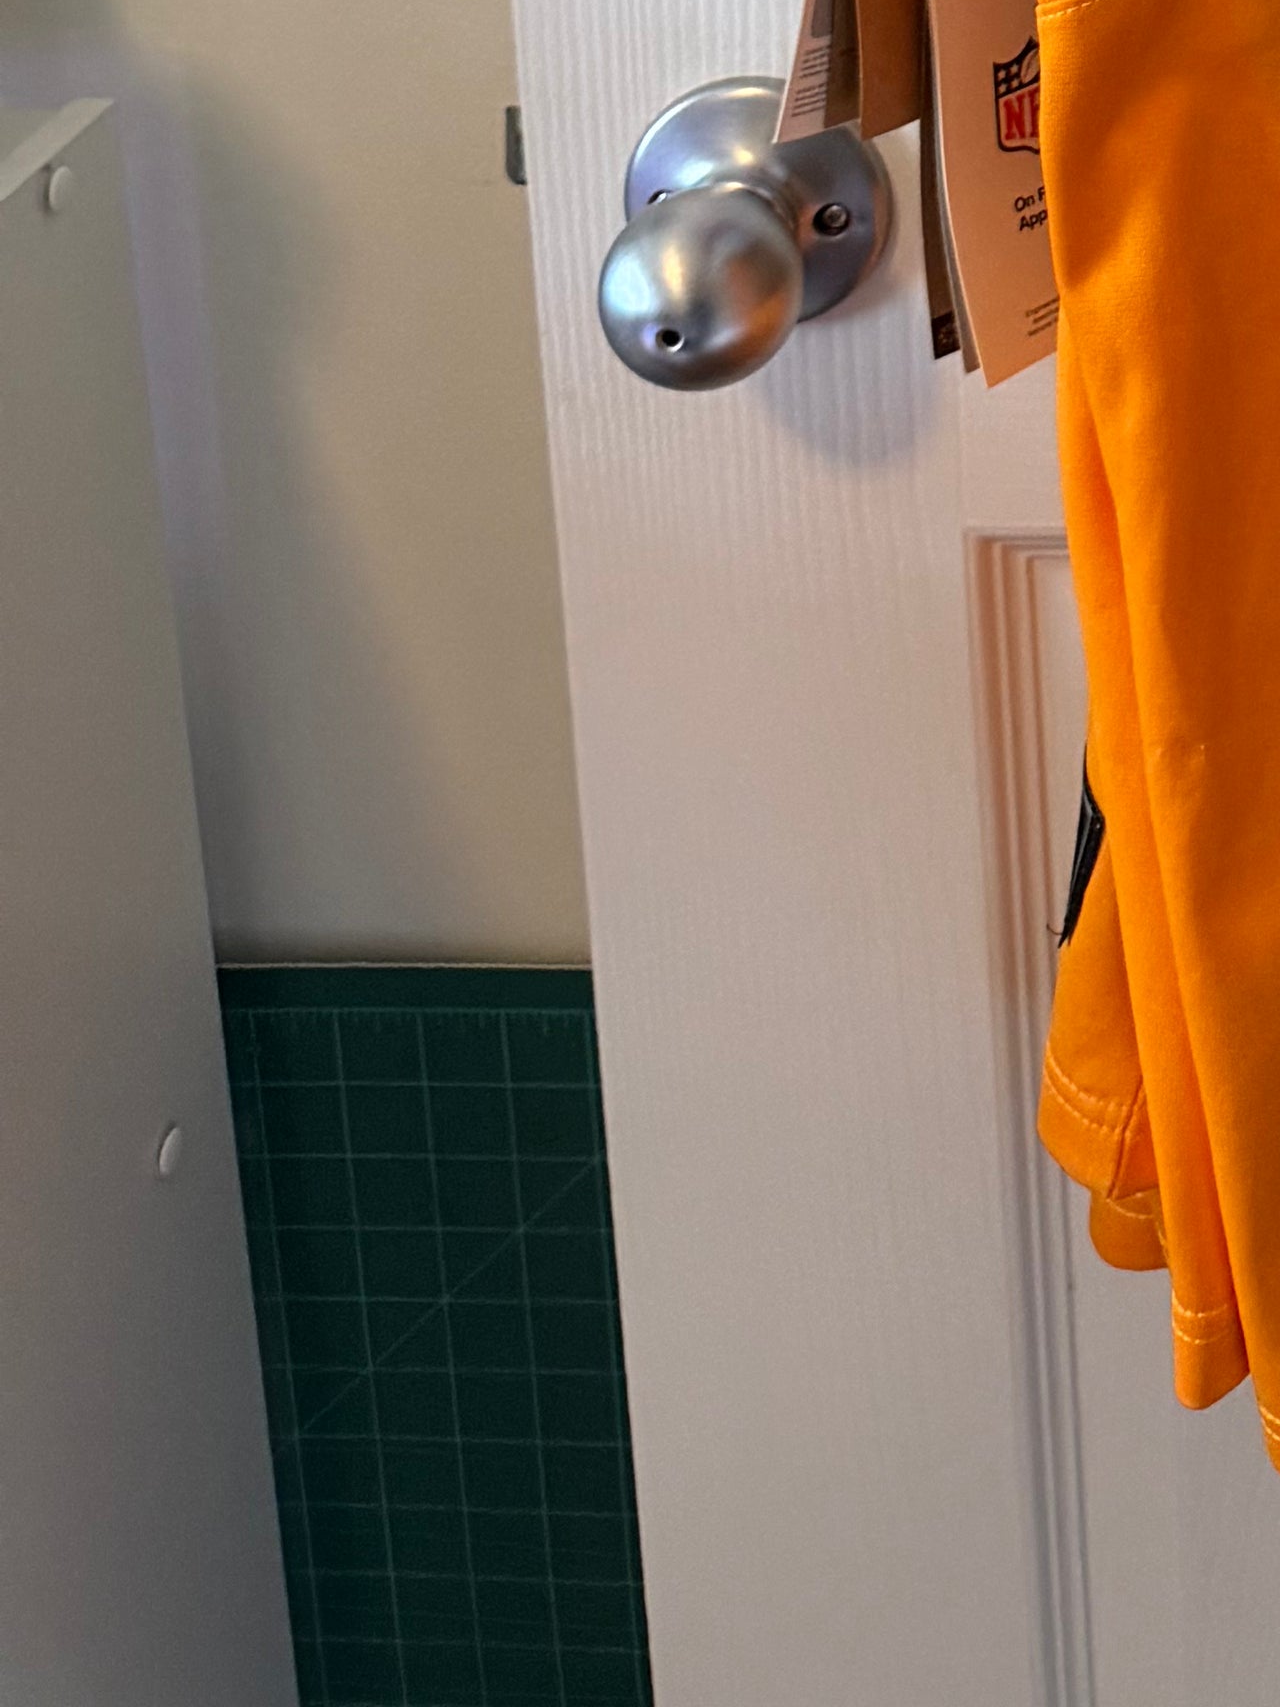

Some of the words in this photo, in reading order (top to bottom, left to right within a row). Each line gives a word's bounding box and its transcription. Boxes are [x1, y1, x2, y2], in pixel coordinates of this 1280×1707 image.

[1003, 85, 1040, 141] NF
[1014, 194, 1036, 213] On
[1018, 208, 1048, 232] App
